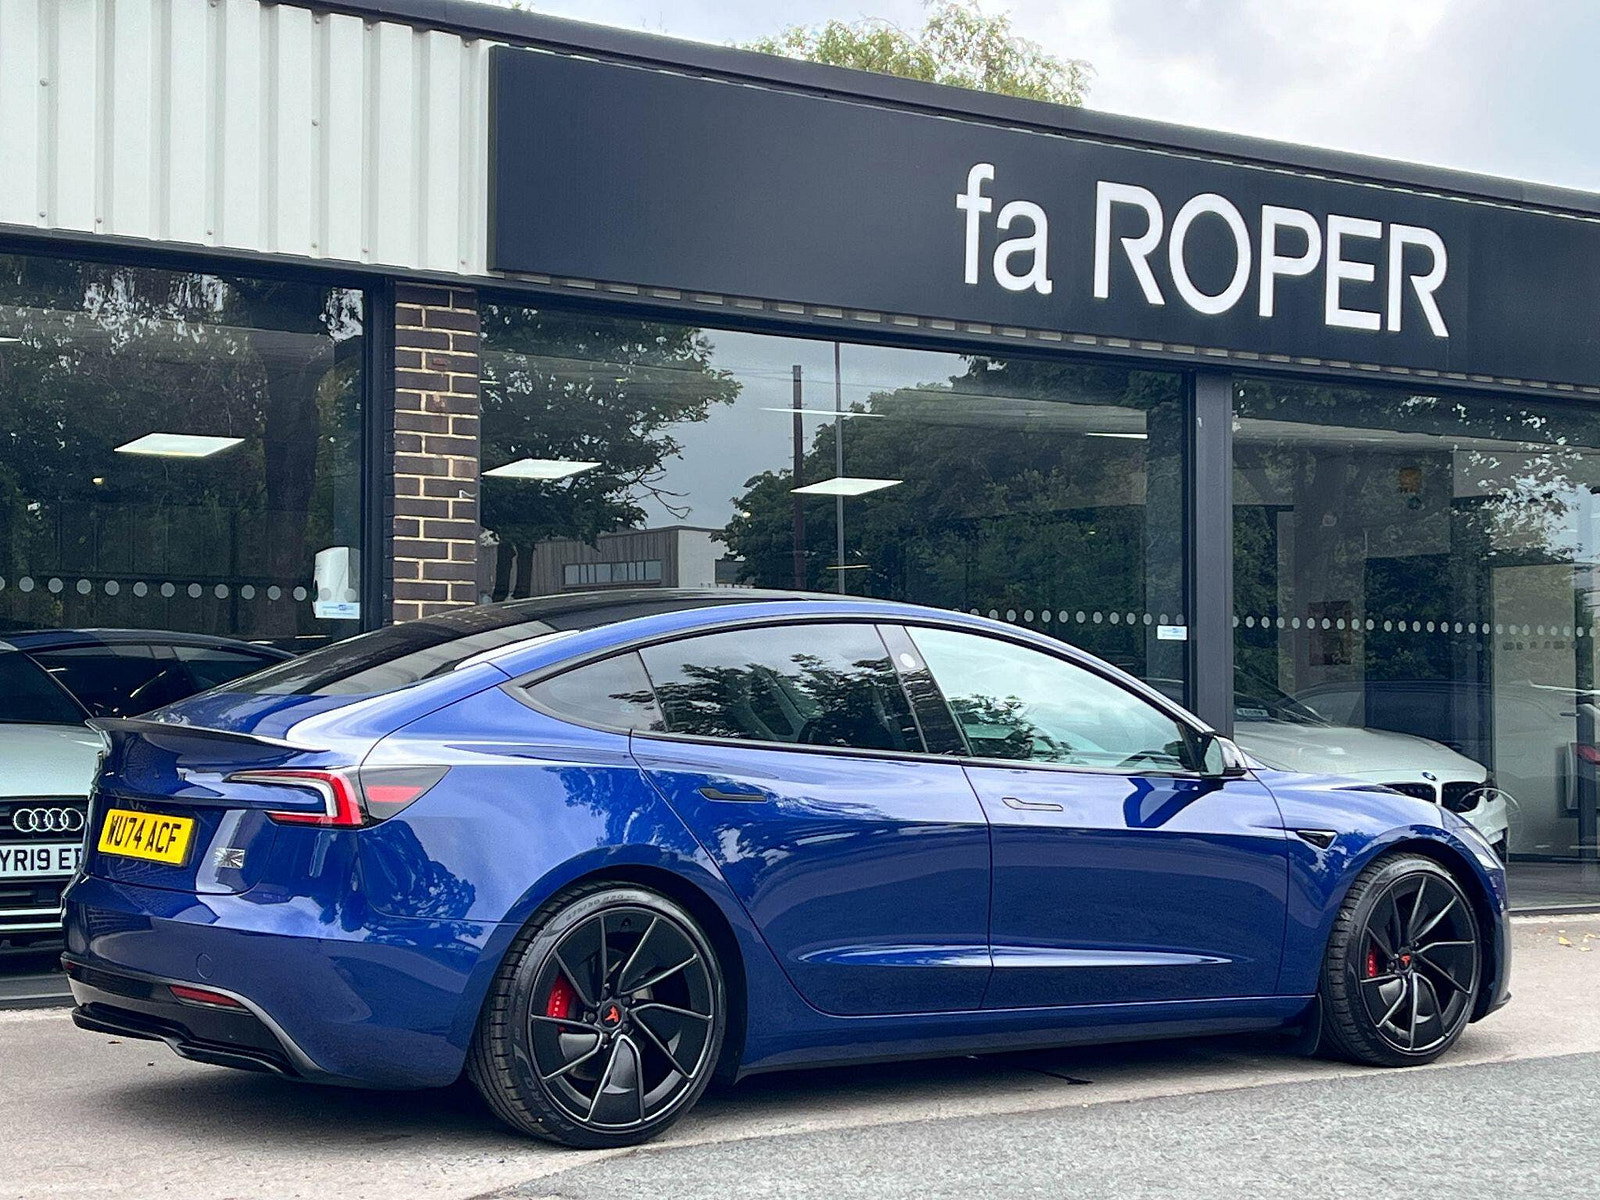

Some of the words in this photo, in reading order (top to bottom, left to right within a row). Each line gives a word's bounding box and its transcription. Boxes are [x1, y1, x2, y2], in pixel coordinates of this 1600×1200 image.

[955, 162, 1053, 295] fa
[1093, 179, 1450, 338] ROPER
[144, 820, 182, 854] ACF
[0, 848, 51, 872] YR19
